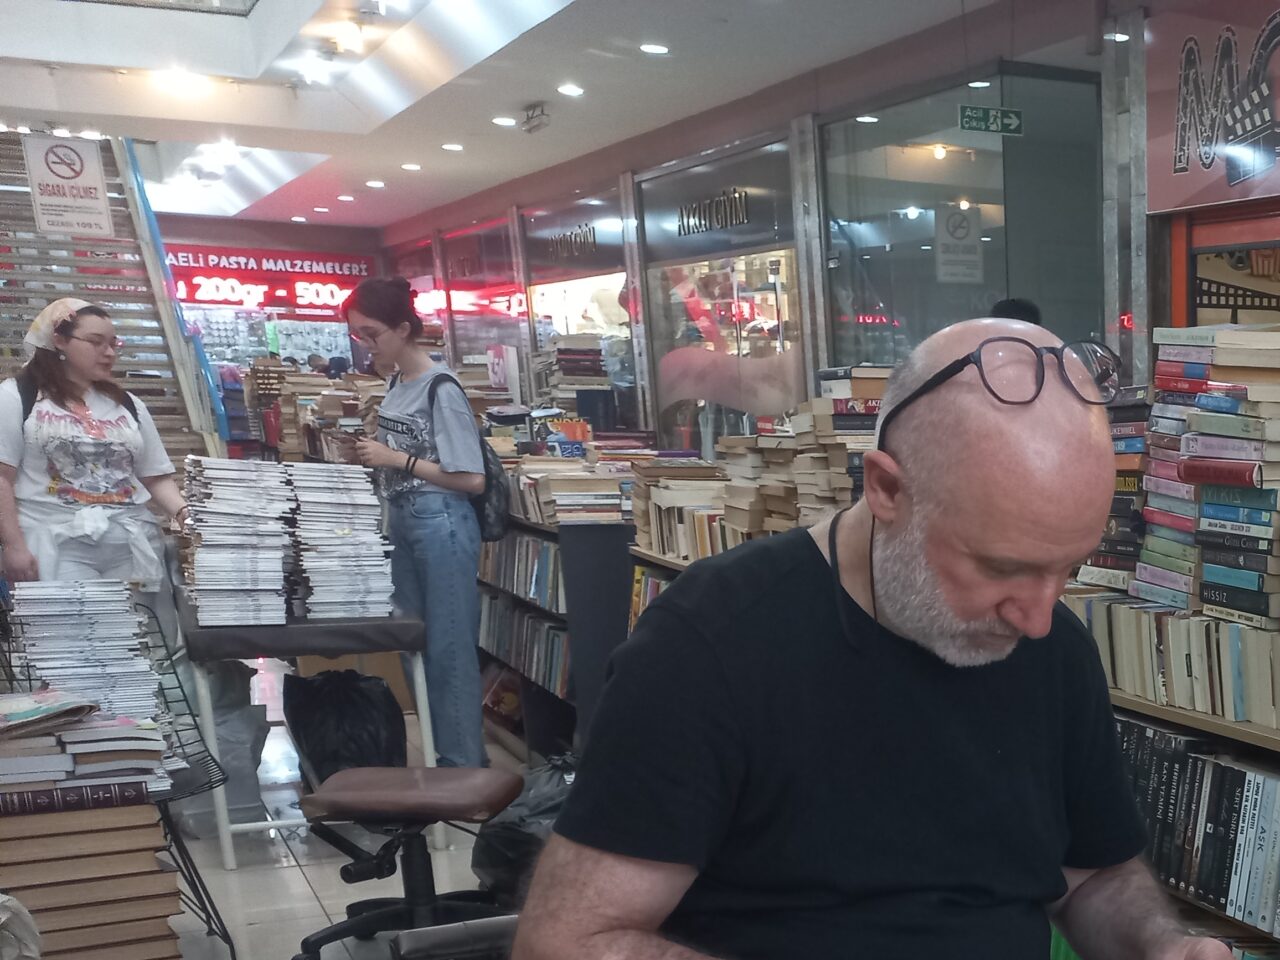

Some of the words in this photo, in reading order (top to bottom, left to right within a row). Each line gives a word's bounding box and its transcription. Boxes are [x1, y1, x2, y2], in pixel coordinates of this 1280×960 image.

[965, 107, 983, 118] Acil
[207, 255, 258, 270] PASTA
[262, 257, 368, 277] MALZEMELERİ
[295, 282, 351, 305] 500
[1232, 786, 1243, 811] SERT
